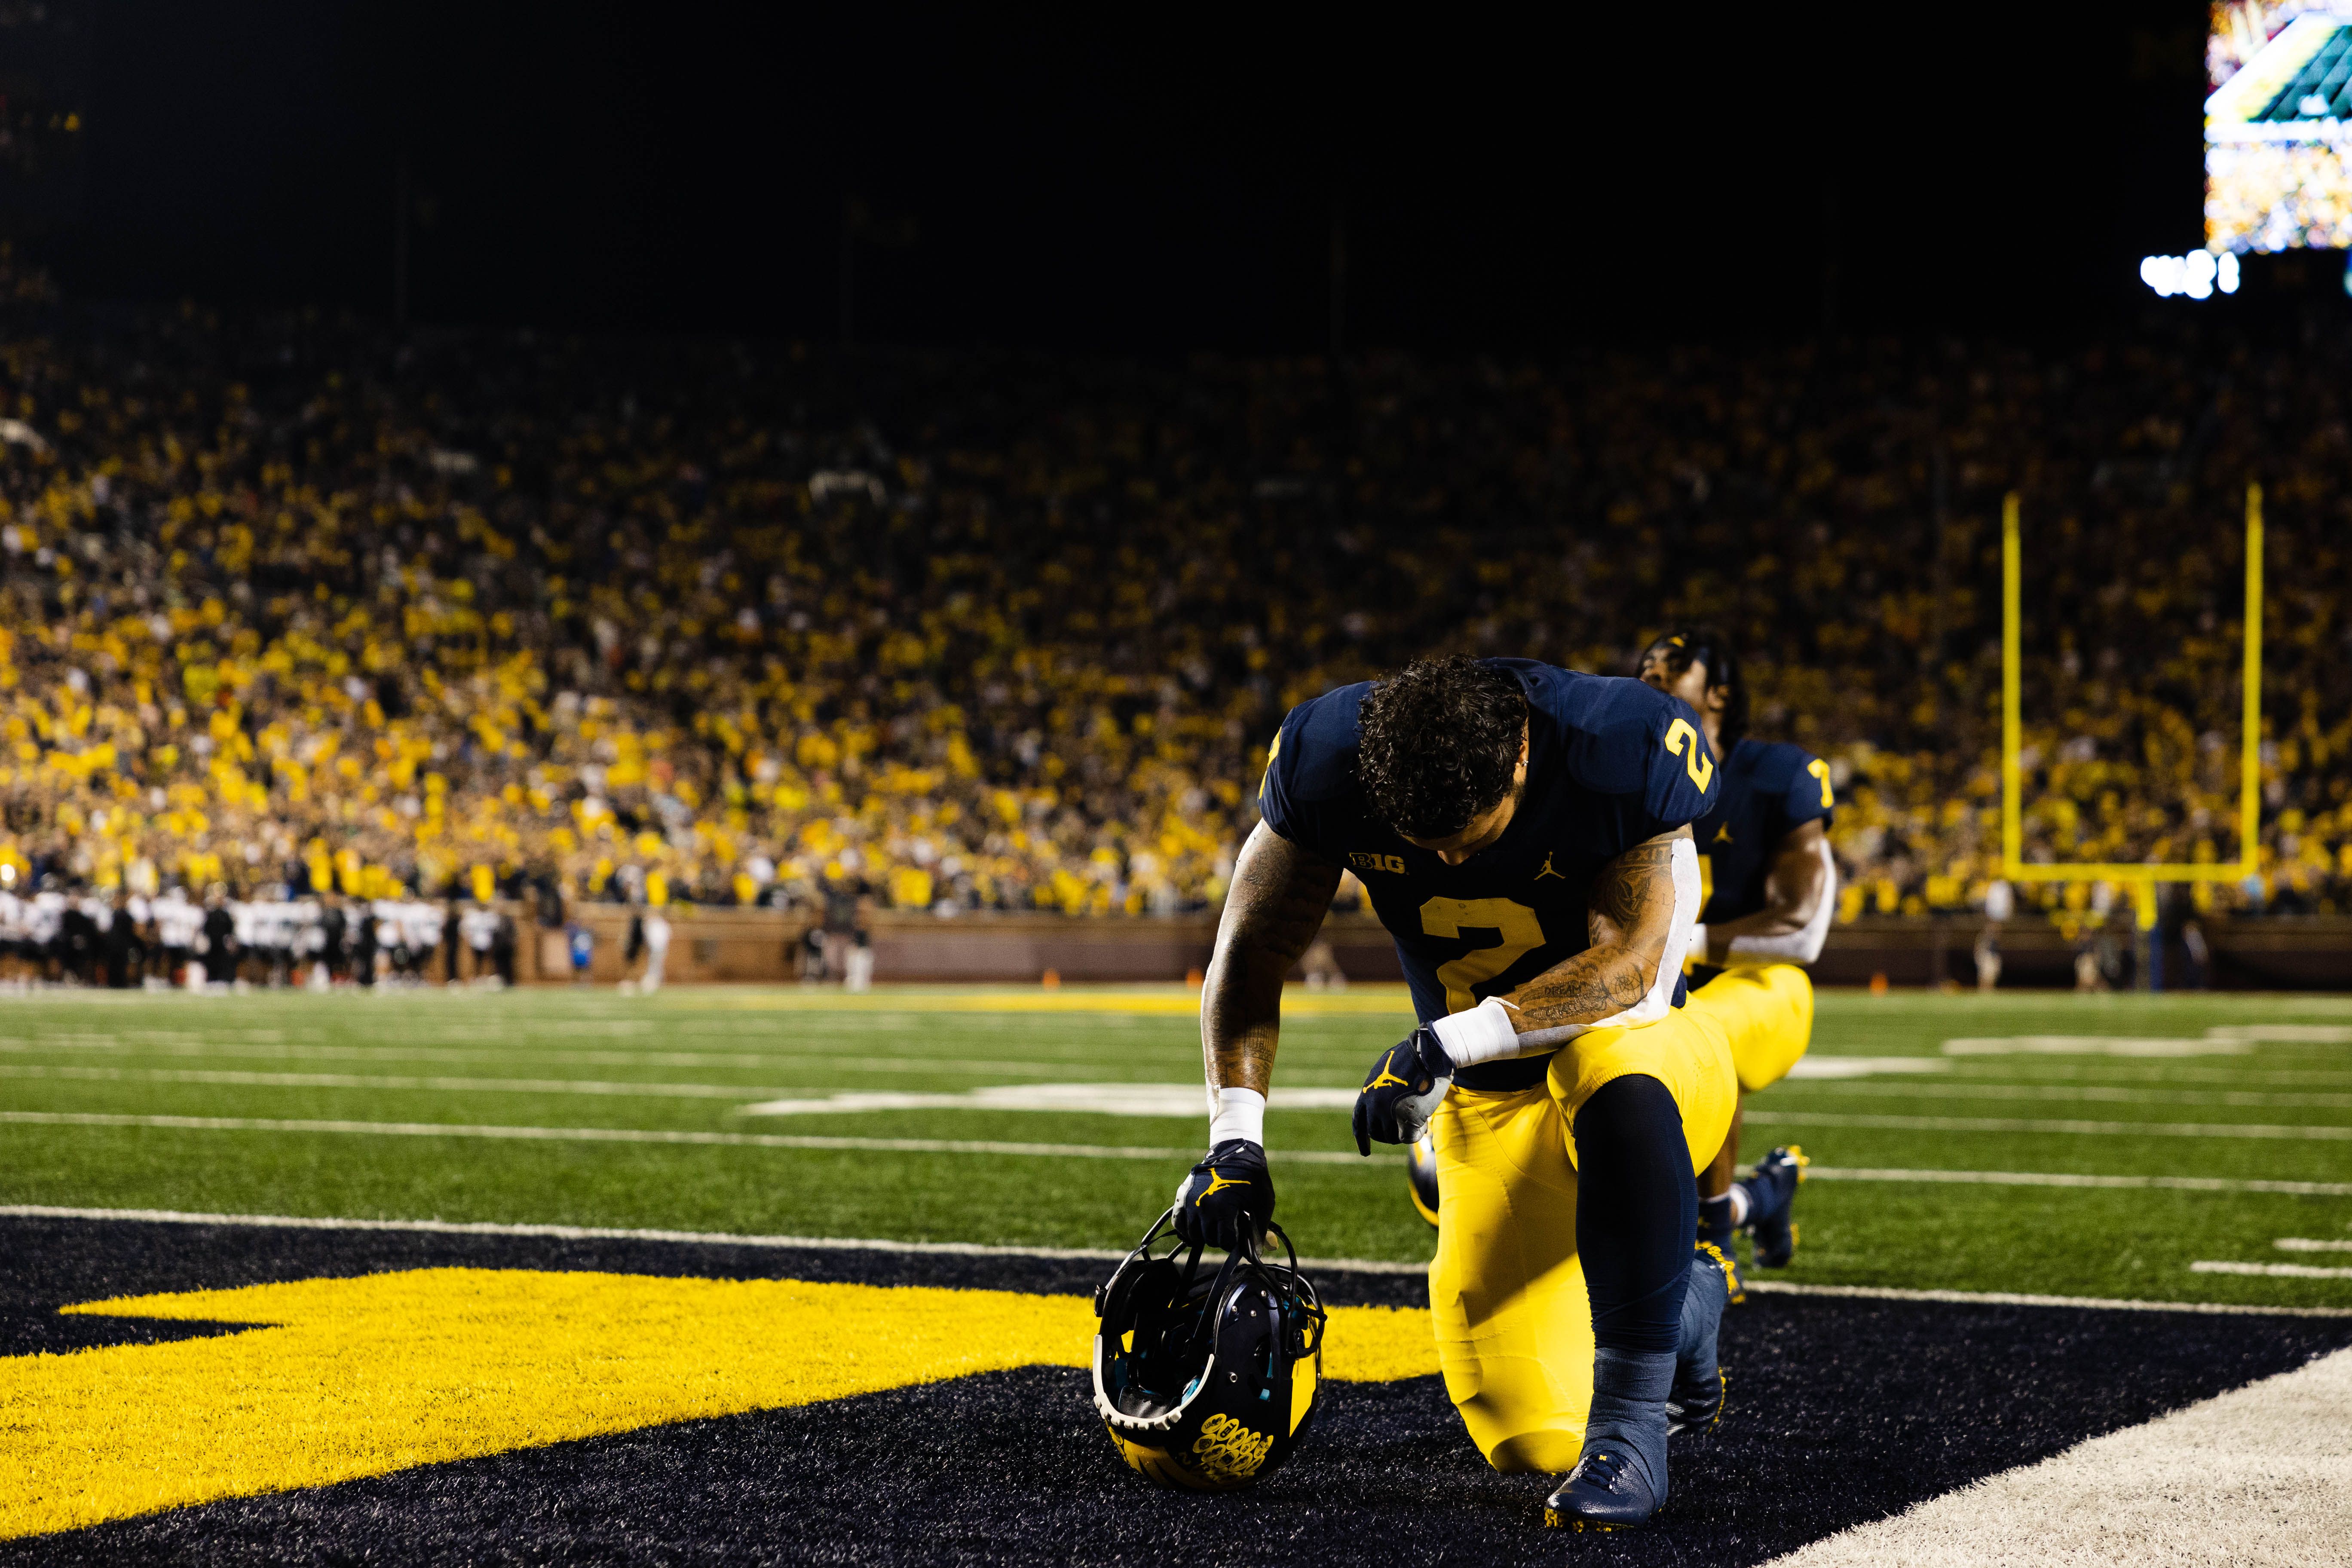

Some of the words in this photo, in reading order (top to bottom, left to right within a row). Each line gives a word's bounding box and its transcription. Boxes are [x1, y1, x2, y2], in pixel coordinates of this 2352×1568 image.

[1665, 719, 1713, 794] 2
[1808, 759, 1834, 808] 7
[1349, 852, 1405, 873] BIG
[1419, 896, 1547, 1015] 2
[1220, 1422, 1237, 1438] TED
